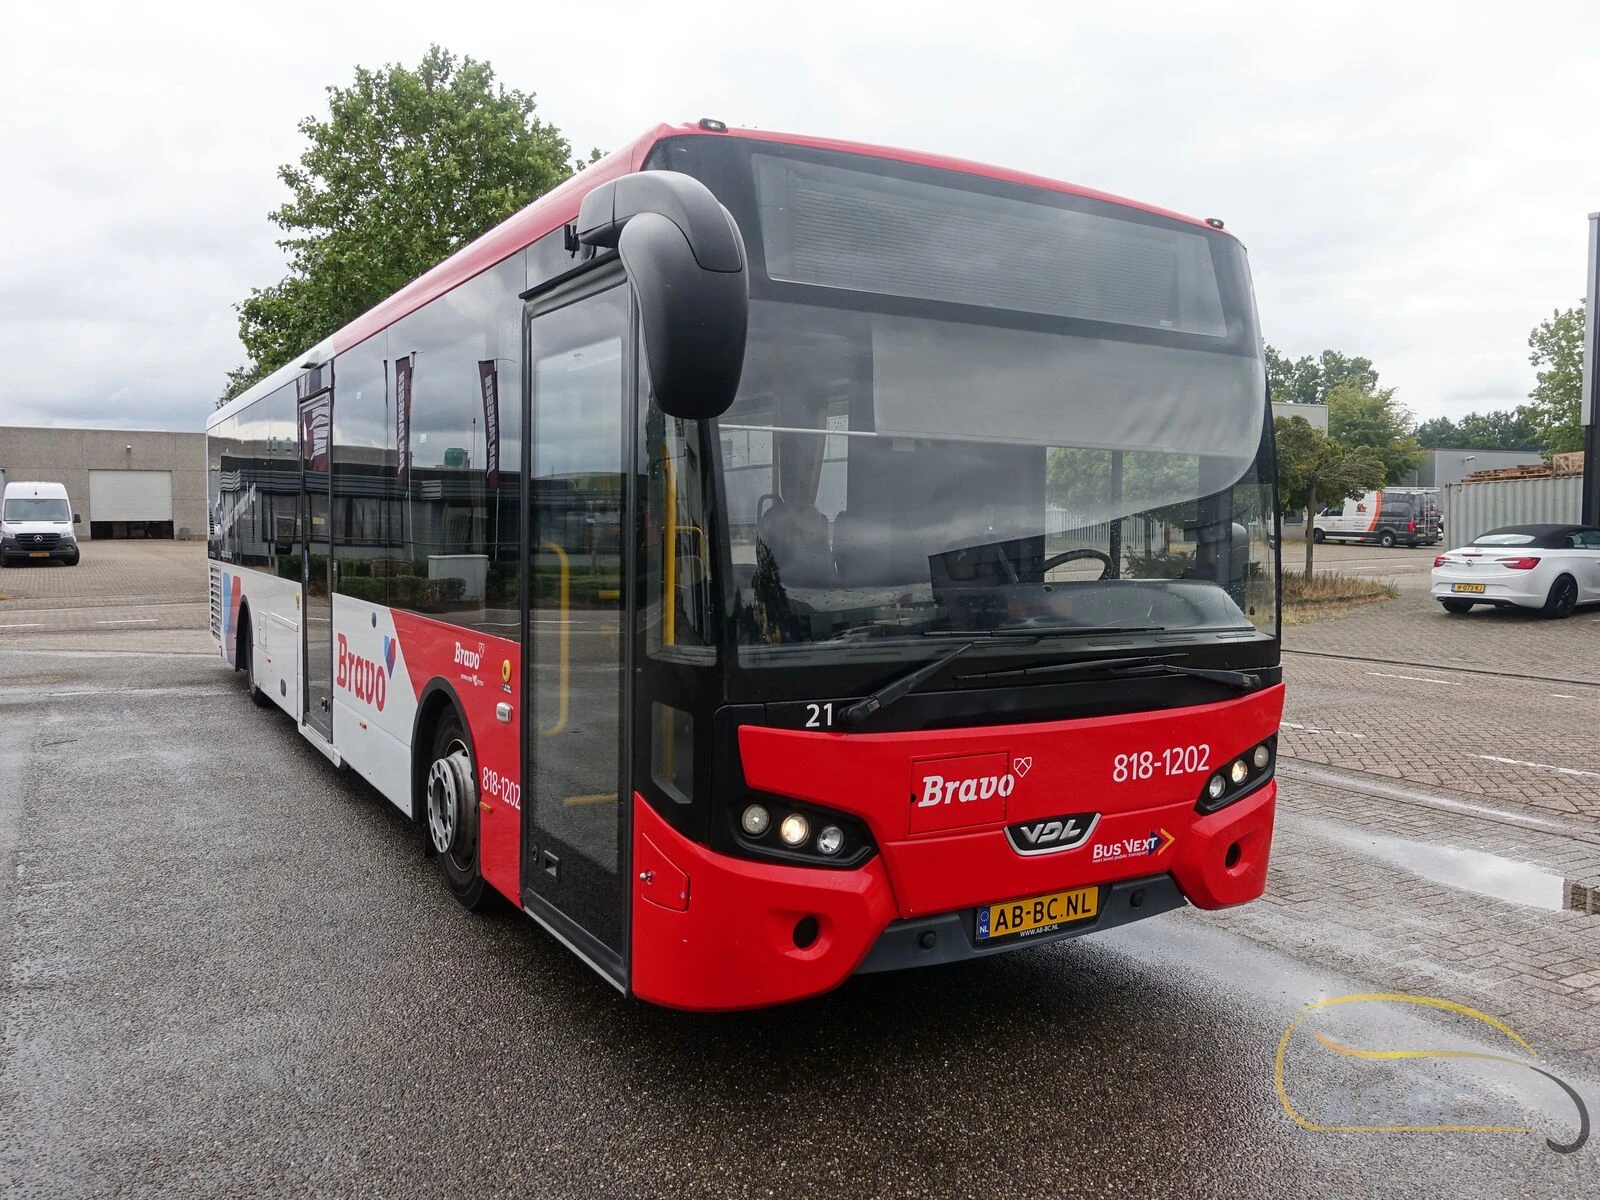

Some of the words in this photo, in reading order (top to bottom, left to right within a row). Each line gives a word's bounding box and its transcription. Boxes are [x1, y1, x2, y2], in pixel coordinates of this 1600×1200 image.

[336, 632, 386, 712] Bravo
[454, 641, 480, 671] Bravo
[806, 703, 834, 728] 21
[1112, 744, 1211, 783] 818-1202
[482, 766, 521, 811] 818-1202
[917, 773, 1015, 808] Bravo
[1020, 819, 1081, 844] VDL
[994, 892, 1092, 932] AB-BC.NL
[979, 926, 989, 934] NL
[1019, 923, 1060, 938] WWW.AB-BC.NL
